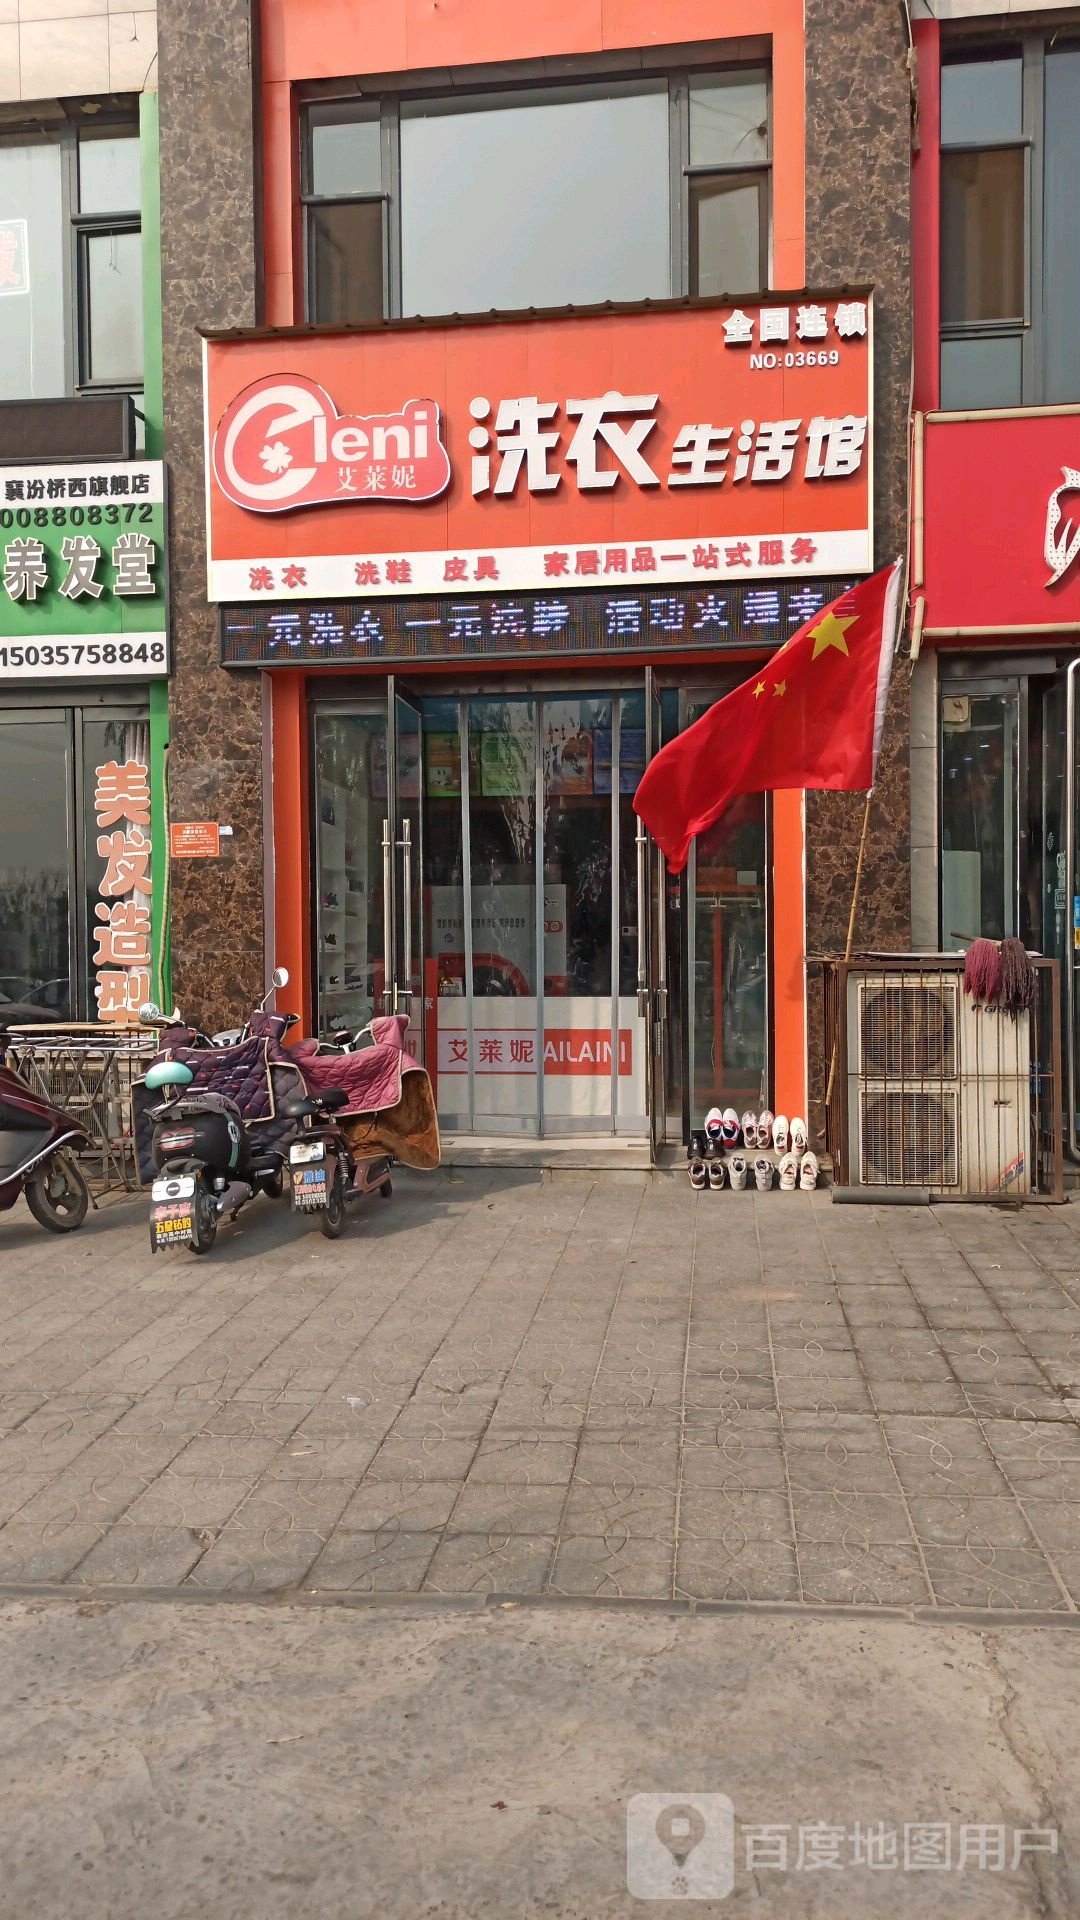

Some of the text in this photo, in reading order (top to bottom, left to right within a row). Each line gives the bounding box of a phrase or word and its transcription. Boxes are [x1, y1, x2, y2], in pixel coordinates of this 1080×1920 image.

[722, 302, 867, 343] 全国连锁
[750, 350, 839, 370] NO:03669
[5, 474, 150, 501] 襄汾桥西旗舰店
[335, 465, 416, 492] 艾莱妮
[3, 533, 155, 600] 养发堂
[248, 537, 817, 590] 洗衣 洗鞋 皮具 家居用品一站式服务
[0, 642, 165, 667] 15035758848
[93, 760, 151, 1025] 美发造型
[448, 1039, 533, 1063] 艾莱妮
